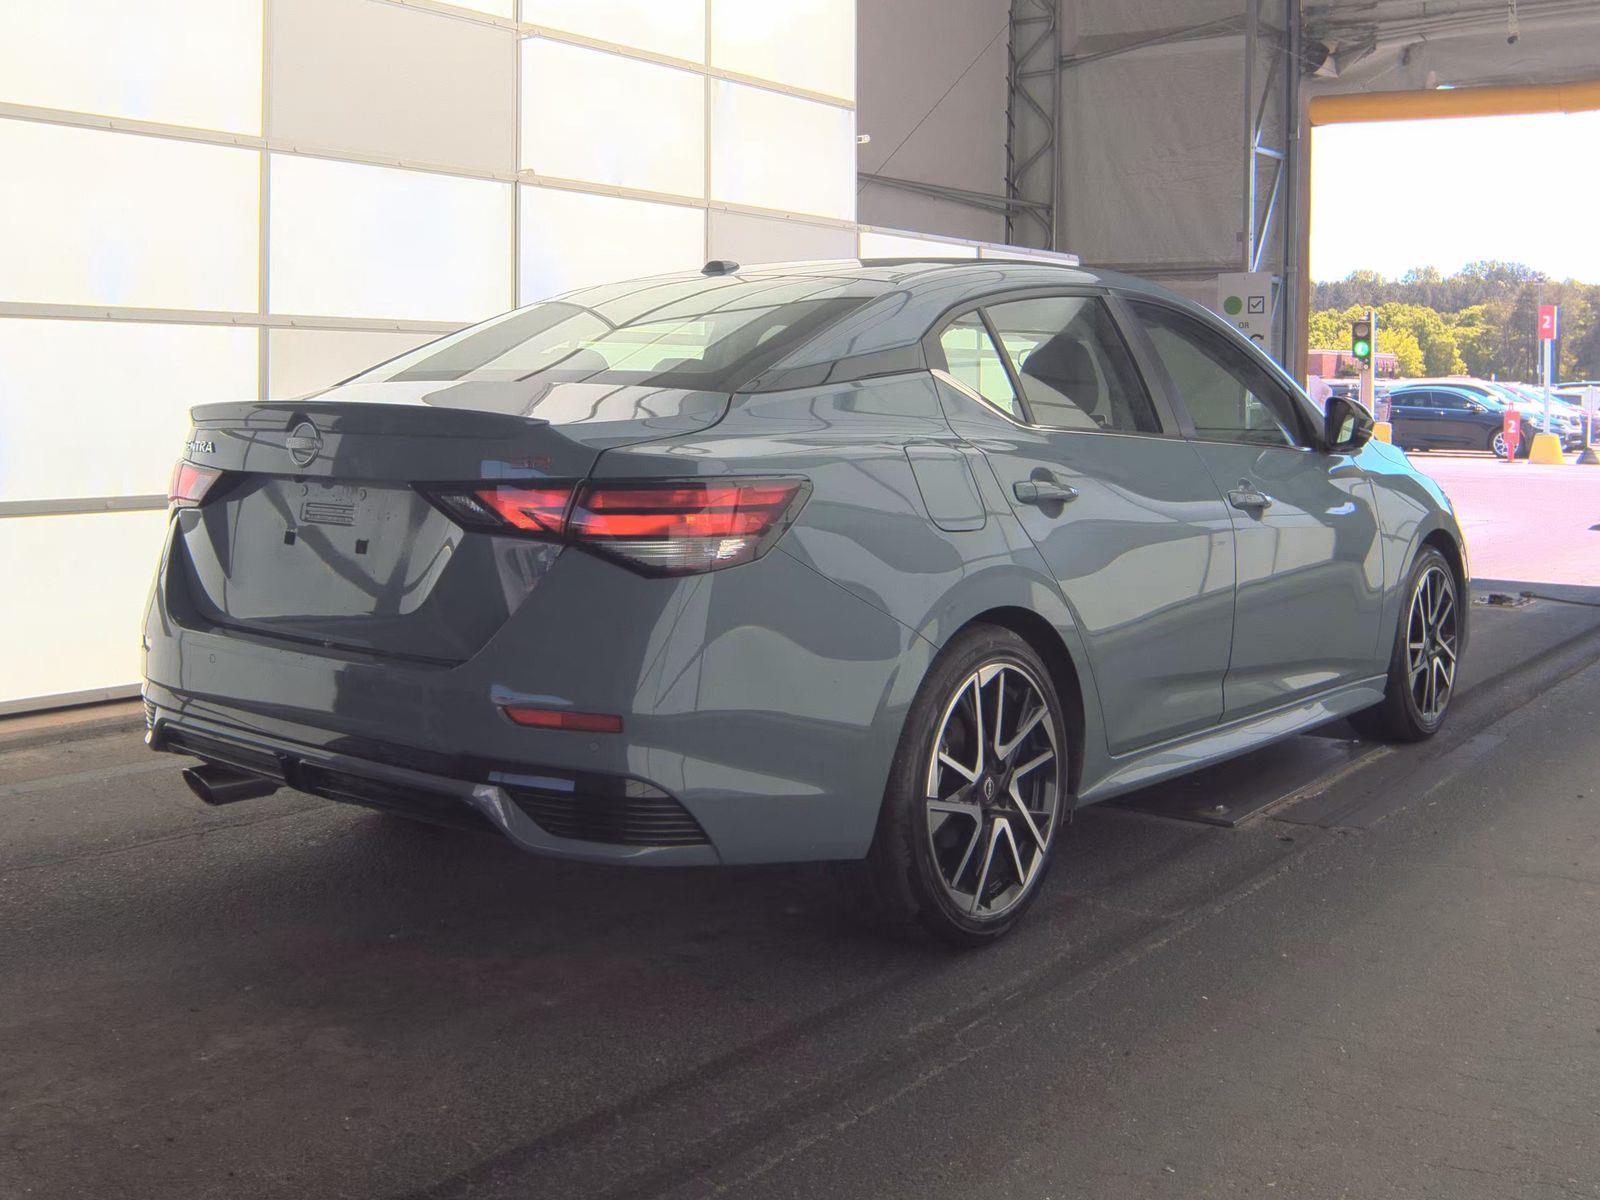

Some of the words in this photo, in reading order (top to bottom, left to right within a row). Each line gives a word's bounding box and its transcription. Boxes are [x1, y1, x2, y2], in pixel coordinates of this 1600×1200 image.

[1238, 321, 1250, 329] OR
[1542, 315, 1552, 329] 2
[1507, 420, 1516, 433] 2
